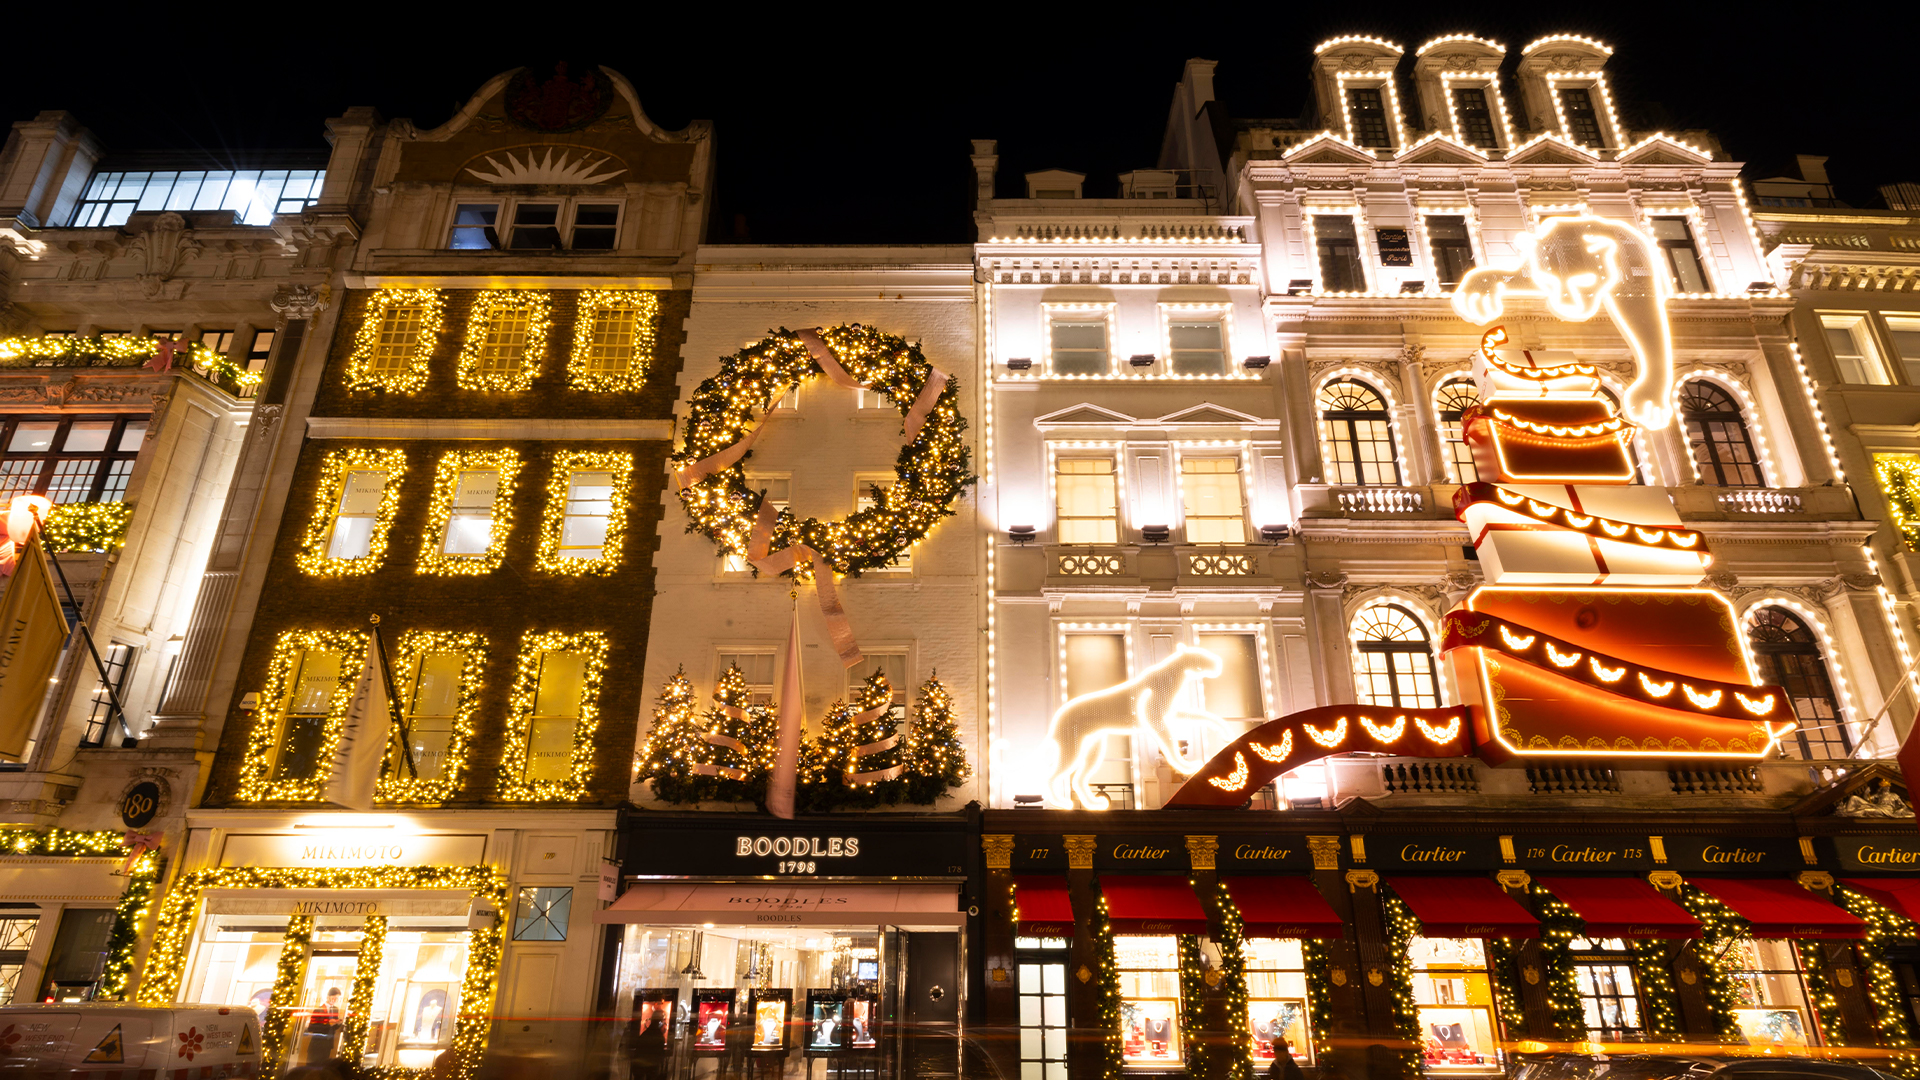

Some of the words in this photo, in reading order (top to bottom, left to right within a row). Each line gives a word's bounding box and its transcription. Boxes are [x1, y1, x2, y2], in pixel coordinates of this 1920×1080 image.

[1380, 232, 1405, 240] Cartier
[123, 793, 153, 819] 180
[735, 836, 859, 857] BOODLES
[1113, 843, 1170, 860] Cartier
[1235, 843, 1292, 860] Cartier
[301, 845, 403, 860] MIKIMOTO
[1029, 848, 1050, 860] 177
[1401, 843, 1466, 862] Cartier
[1526, 848, 1546, 859] 176
[1551, 844, 1617, 863] Cartier
[1623, 848, 1643, 859] 175
[1702, 845, 1767, 864] Cartier
[1857, 845, 1920, 864] Cartier
[778, 860, 817, 874] 1798
[947, 865, 962, 873] 178
[727, 897, 848, 905] BOODLES
[294, 901, 378, 914] MIKIMOTO
[756, 914, 802, 923] BOODLES
[1030, 923, 1062, 934] Cartier
[1141, 920, 1174, 931] Cartier
[1276, 924, 1310, 935] Cartier
[1464, 924, 1497, 934] Cartier
[1627, 925, 1660, 935] Cartier
[1792, 925, 1825, 935] Cartier
[29, 1023, 52, 1032] NEW
[24, 1034, 48, 1042] WEST
[47, 1034, 65, 1043] END
[206, 1031, 221, 1039] WEST
[222, 1030, 233, 1039] END
[19, 1043, 63, 1053] COMPANY
